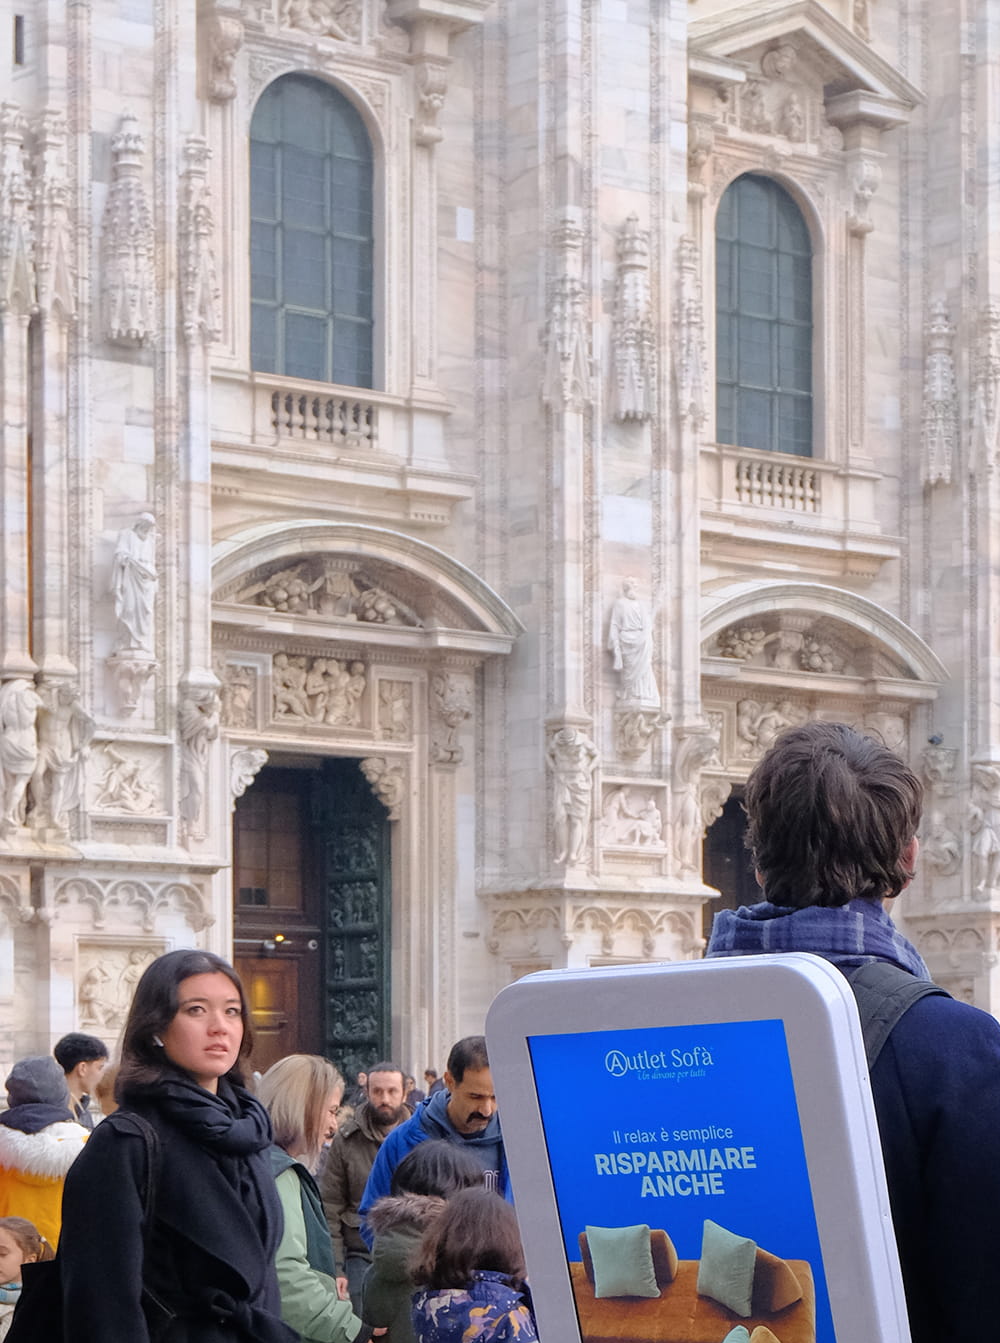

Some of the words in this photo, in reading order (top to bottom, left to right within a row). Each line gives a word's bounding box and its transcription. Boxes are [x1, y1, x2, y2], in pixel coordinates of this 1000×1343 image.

[671, 1046, 714, 1068] Sofà
[677, 1070, 688, 1083] per
[613, 1130, 621, 1144] Il
[625, 1129, 657, 1143] relax
[660, 1127, 669, 1142] è
[673, 1125, 734, 1143] semplice
[594, 1147, 757, 1175] RISPARMIARE
[641, 1173, 725, 1197] ANCHE
